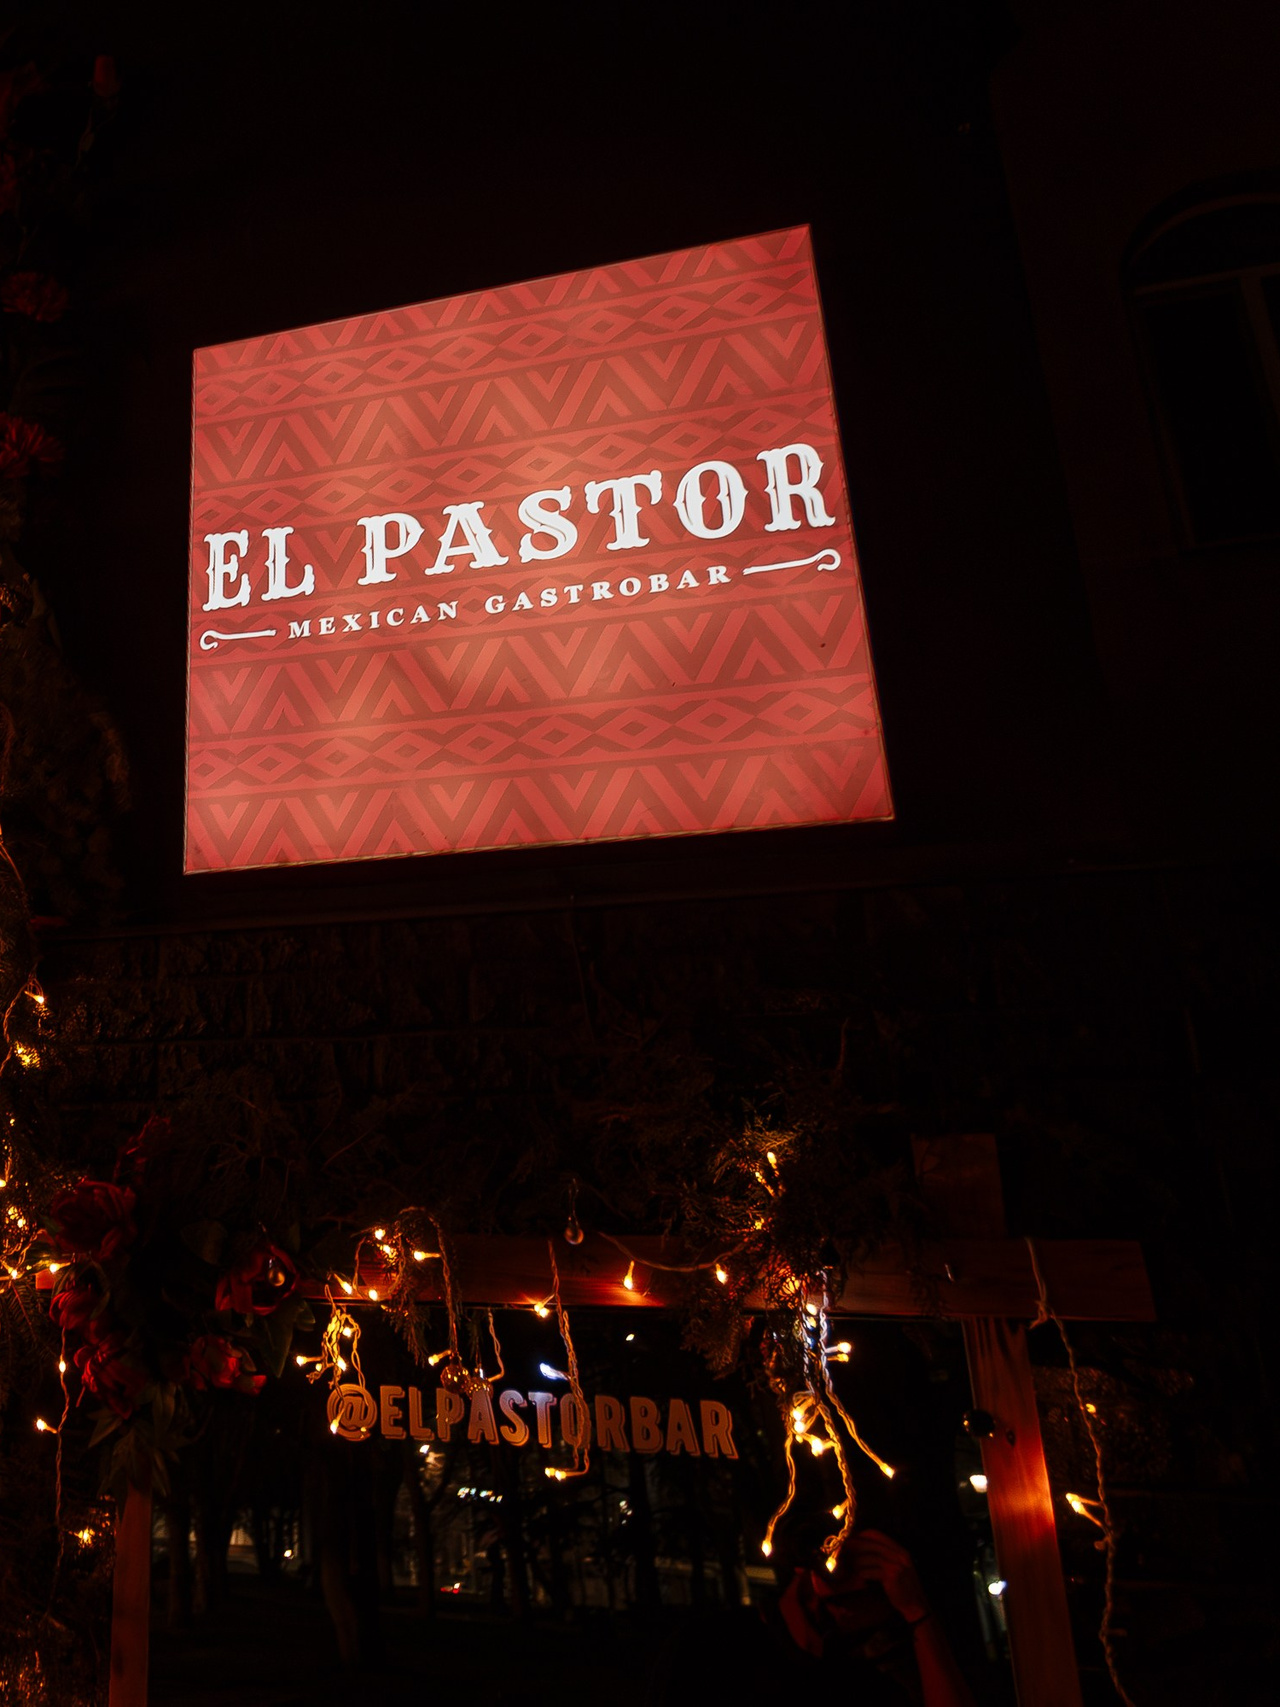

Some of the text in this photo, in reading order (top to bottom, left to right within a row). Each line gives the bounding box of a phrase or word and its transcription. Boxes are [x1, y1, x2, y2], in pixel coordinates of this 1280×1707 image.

[202, 443, 835, 612] EL PASTOR
[287, 563, 731, 639] MEXICAN GASTROBAR
[327, 1382, 740, 1460] @ELPASTORBAR
